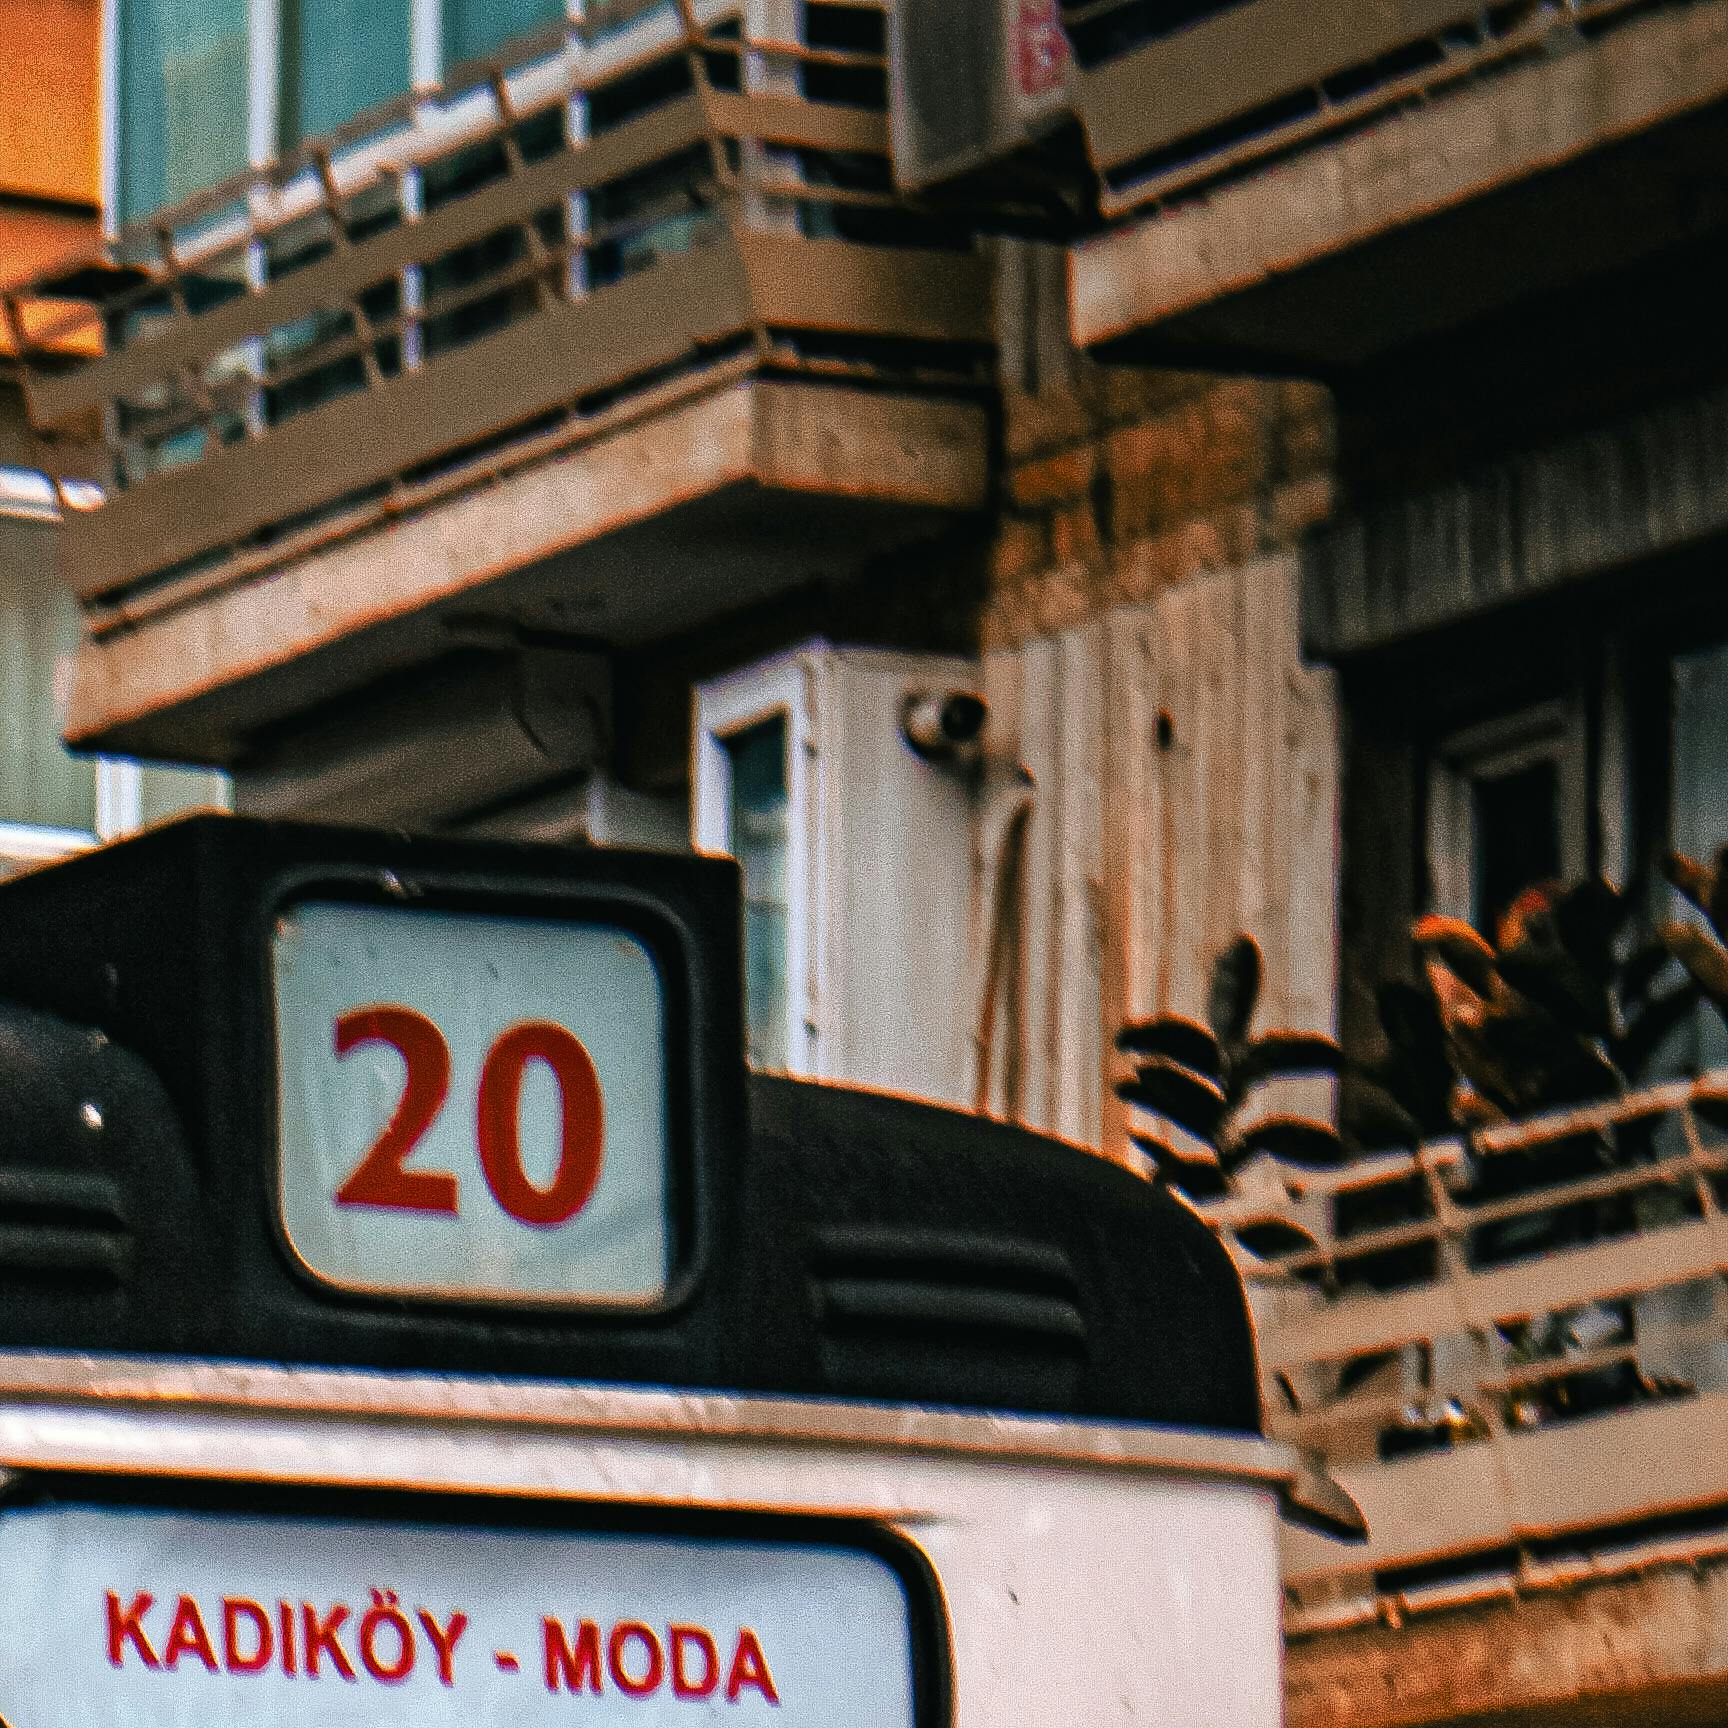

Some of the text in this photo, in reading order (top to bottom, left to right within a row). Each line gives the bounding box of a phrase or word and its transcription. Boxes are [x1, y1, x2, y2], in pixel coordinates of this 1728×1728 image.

[334, 1001, 606, 1230] 20
[104, 1587, 782, 1707] KADIKÖY - MODA
